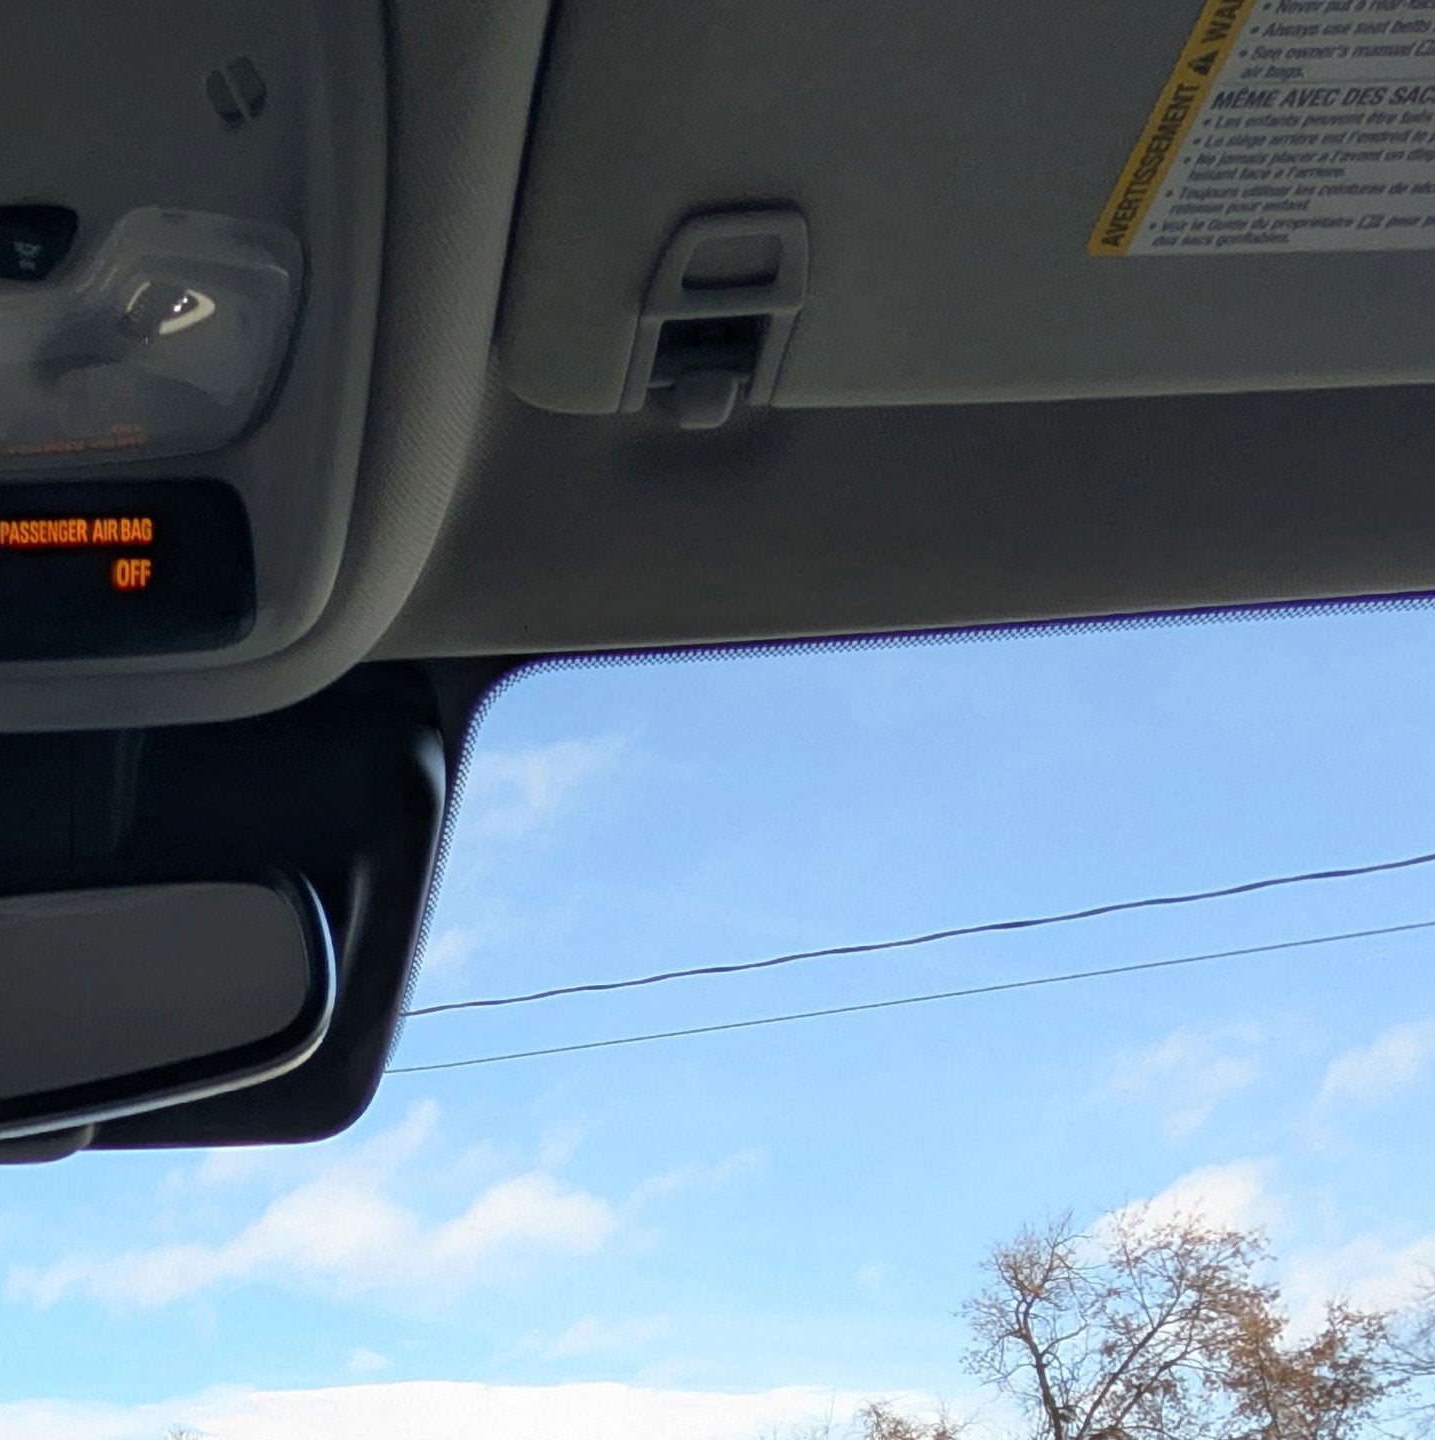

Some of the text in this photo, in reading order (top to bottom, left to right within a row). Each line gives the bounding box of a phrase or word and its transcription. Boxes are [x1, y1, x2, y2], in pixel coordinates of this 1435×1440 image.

[1240, 67, 1262, 79] air
[1211, 86, 1279, 109] MÊME
[1280, 88, 1340, 107] AVEC
[1342, 87, 1388, 106] DES
[1101, 84, 1200, 247] AVERTISSEMENT
[0, 517, 153, 543] PASSENGER AIR BAG
[117, 559, 151, 587] OFF
